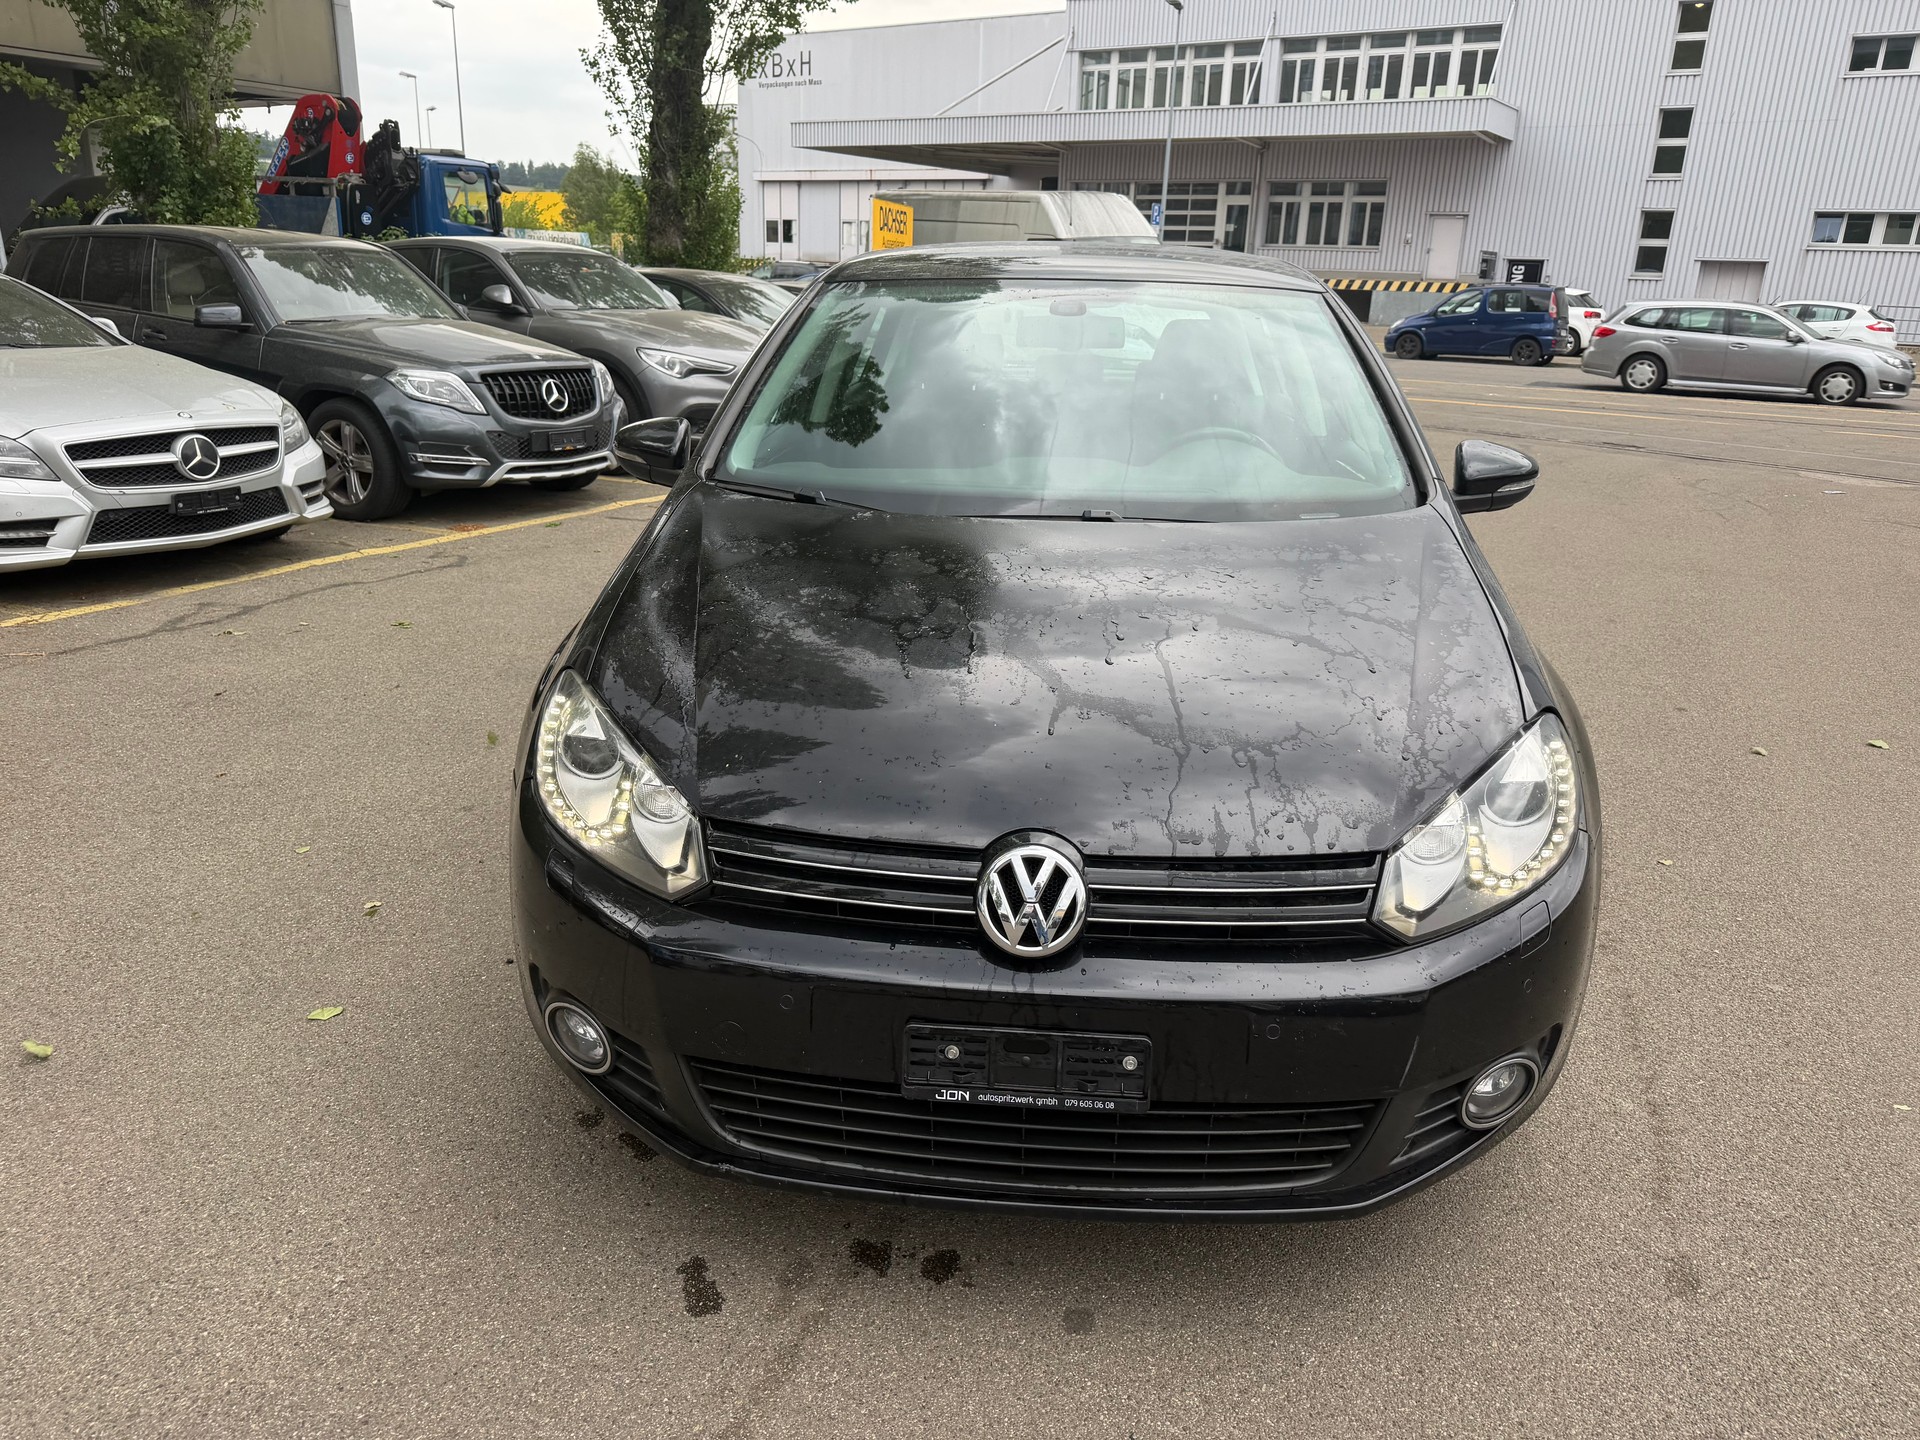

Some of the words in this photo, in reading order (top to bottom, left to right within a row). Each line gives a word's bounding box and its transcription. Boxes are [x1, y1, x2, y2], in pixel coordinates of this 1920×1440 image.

[758, 81, 794, 90] Verpackungen
[808, 78, 823, 86] Mass
[879, 205, 907, 235] DACHSER
[935, 1089, 970, 1102] JON
[977, 1093, 1034, 1104] autospritzwerk
[1064, 1098, 1078, 1107] 079
[1079, 1099, 1093, 1108] 605
[1094, 1100, 1104, 1109] 06
[1105, 1101, 1115, 1109] 08
